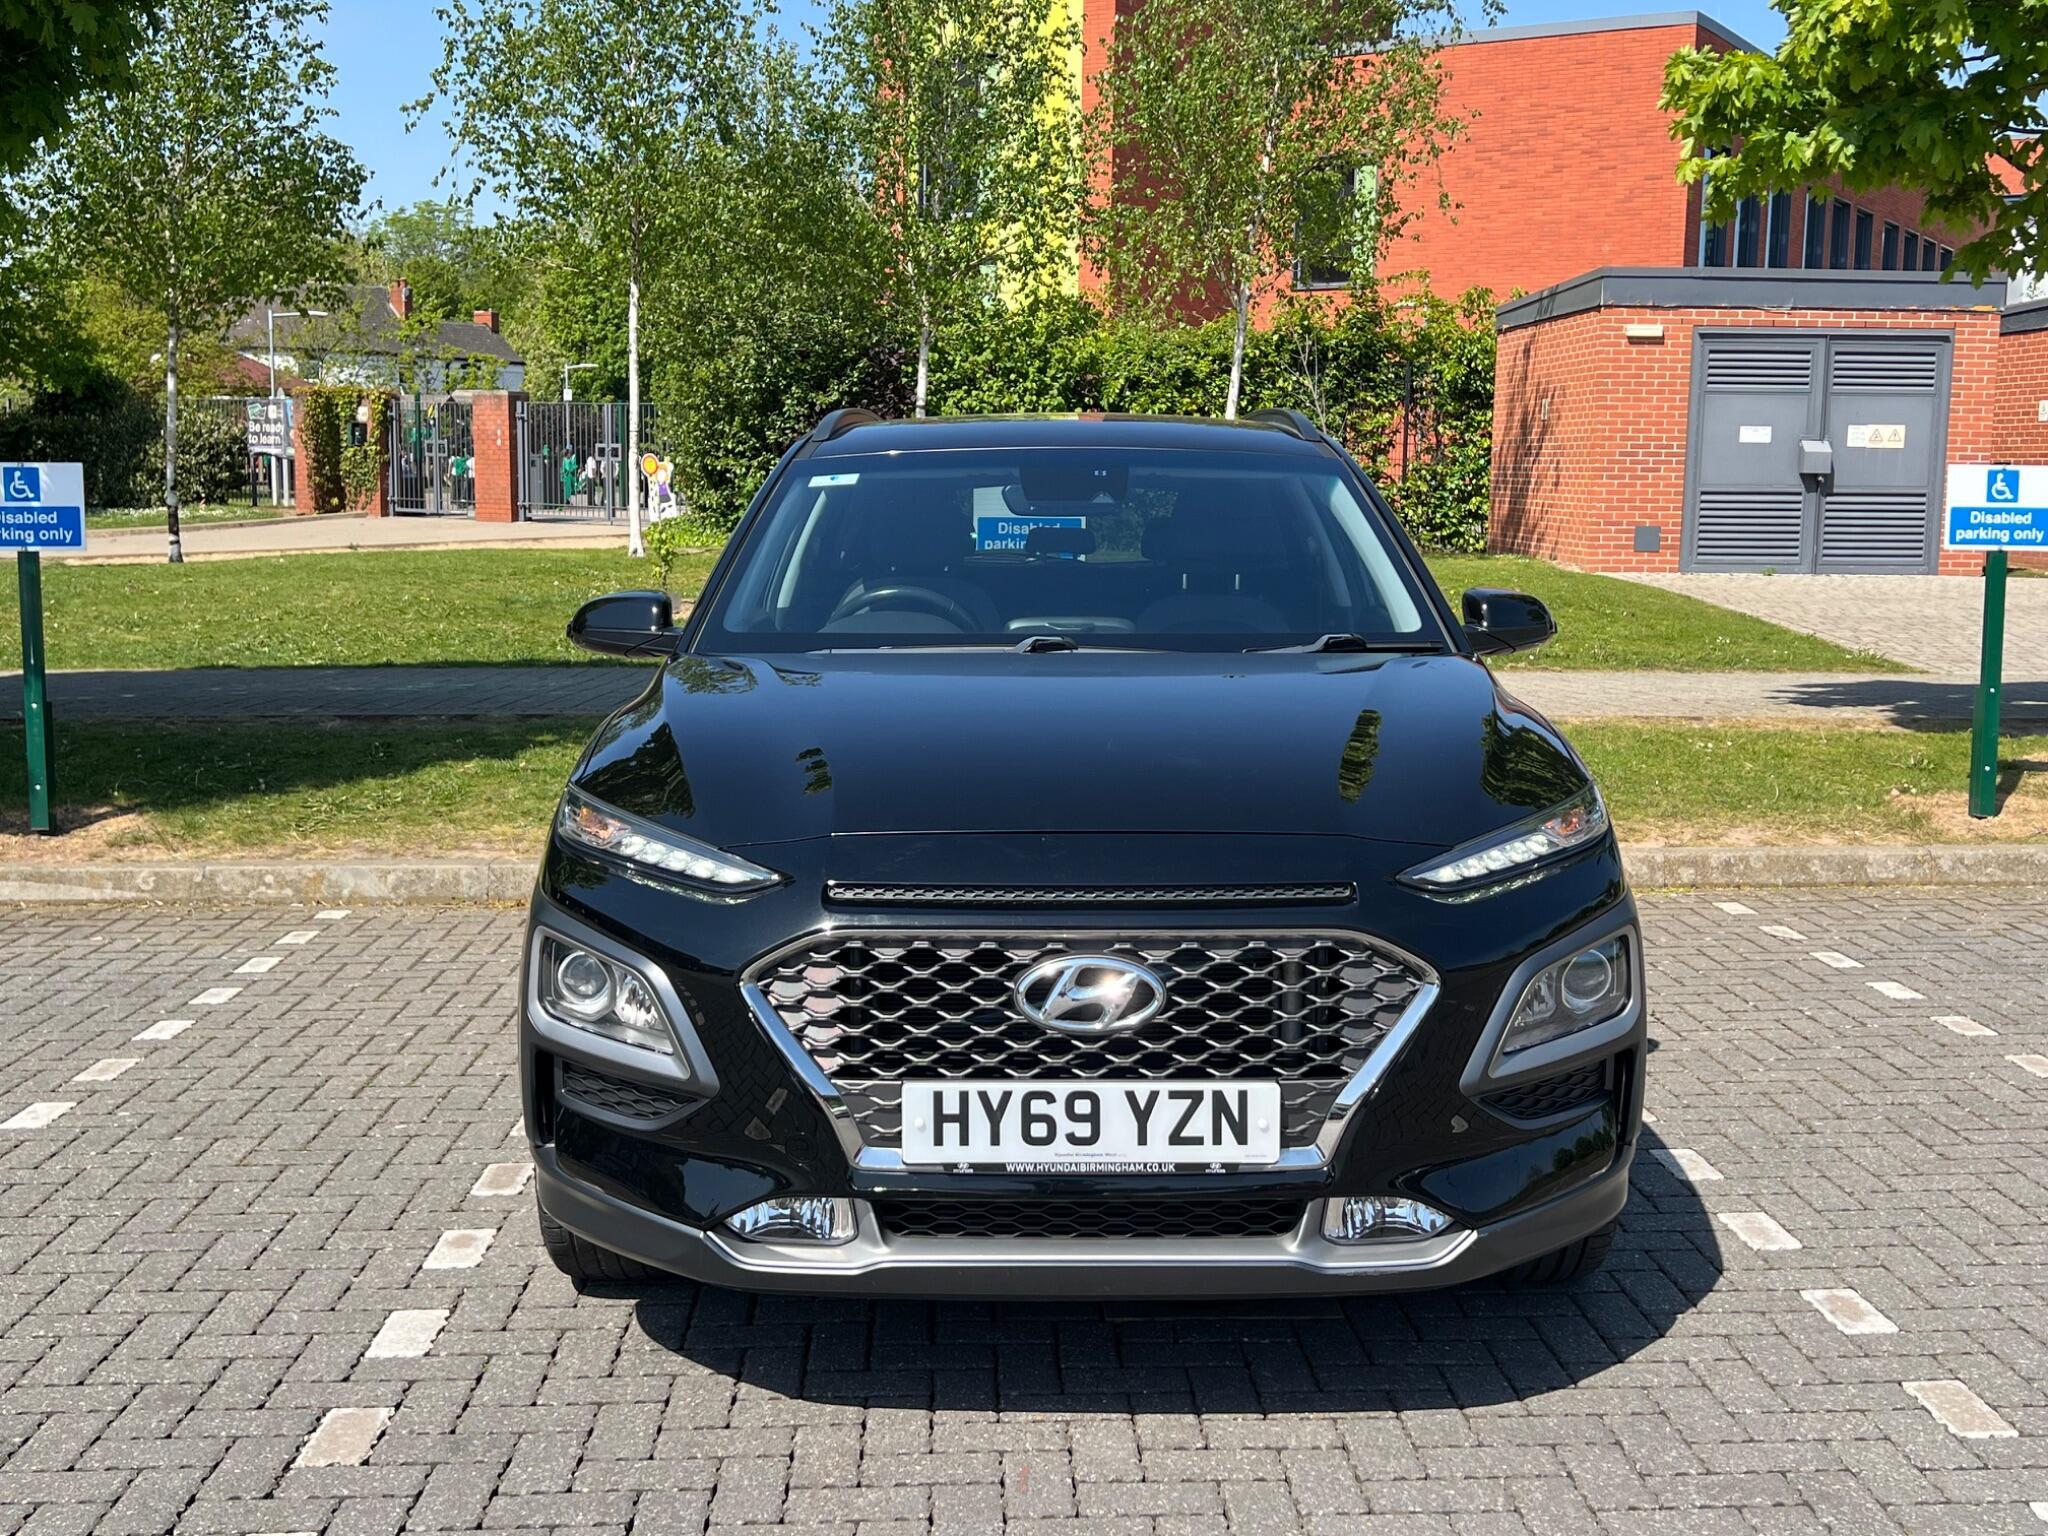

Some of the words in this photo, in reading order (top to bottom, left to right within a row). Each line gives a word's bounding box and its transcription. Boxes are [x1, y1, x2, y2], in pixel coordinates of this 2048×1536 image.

[249, 421, 261, 432] Be
[263, 421, 284, 435] ready
[248, 433, 258, 444] to
[260, 433, 281, 444] learn
[0, 511, 57, 524] isabled
[1970, 511, 2032, 524] Disabled
[0, 527, 34, 543] king
[39, 527, 73, 543] only
[1955, 527, 2010, 543] parking
[2013, 528, 2044, 543] only
[933, 1090, 1100, 1146] HY69
[1124, 1090, 1248, 1146] YZN
[1006, 1162, 1176, 1173] WWW.HYUNDAIBIRMINGHAM.CO.UK
